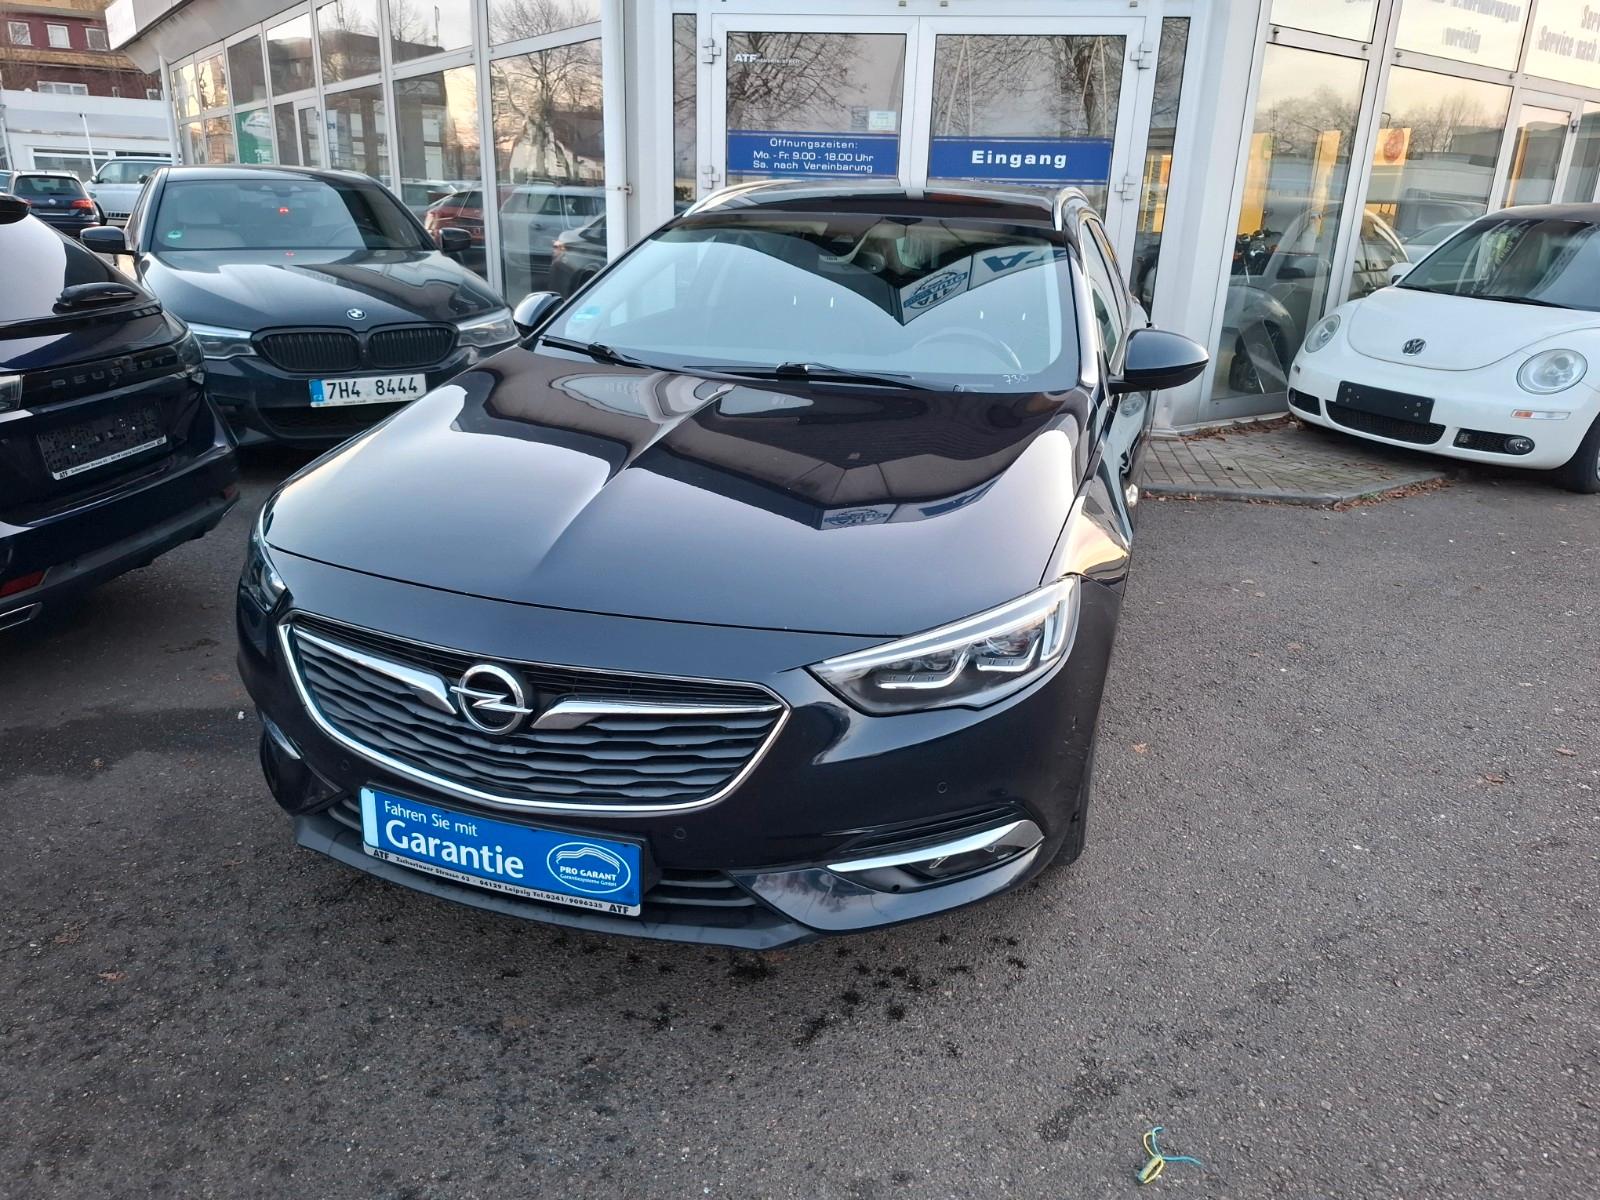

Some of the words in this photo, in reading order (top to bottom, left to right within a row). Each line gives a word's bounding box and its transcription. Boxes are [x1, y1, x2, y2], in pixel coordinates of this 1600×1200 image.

[1539, 25, 1574, 56] Service
[734, 53, 758, 63] ATF
[769, 137, 859, 150] Öffnungszeiten:
[753, 160, 769, 169] Sa.
[773, 161, 799, 169] nach
[803, 162, 873, 173] Vereinbarung
[792, 152, 816, 160] 9.00
[824, 153, 853, 162] 18.00
[855, 153, 874, 162] Uhr
[971, 150, 1067, 169] Eingang
[326, 380, 361, 399] 7H4
[375, 377, 418, 396] 8444
[384, 800, 427, 824] Fahren
[432, 813, 450, 830] Sie
[455, 822, 478, 837] mit
[385, 819, 524, 879] Garantie
[373, 849, 390, 860] ATF
[479, 879, 502, 890] 04129
[609, 904, 630, 914] ATF
[560, 866, 578, 875] PRO
[580, 869, 617, 881] GARANT
